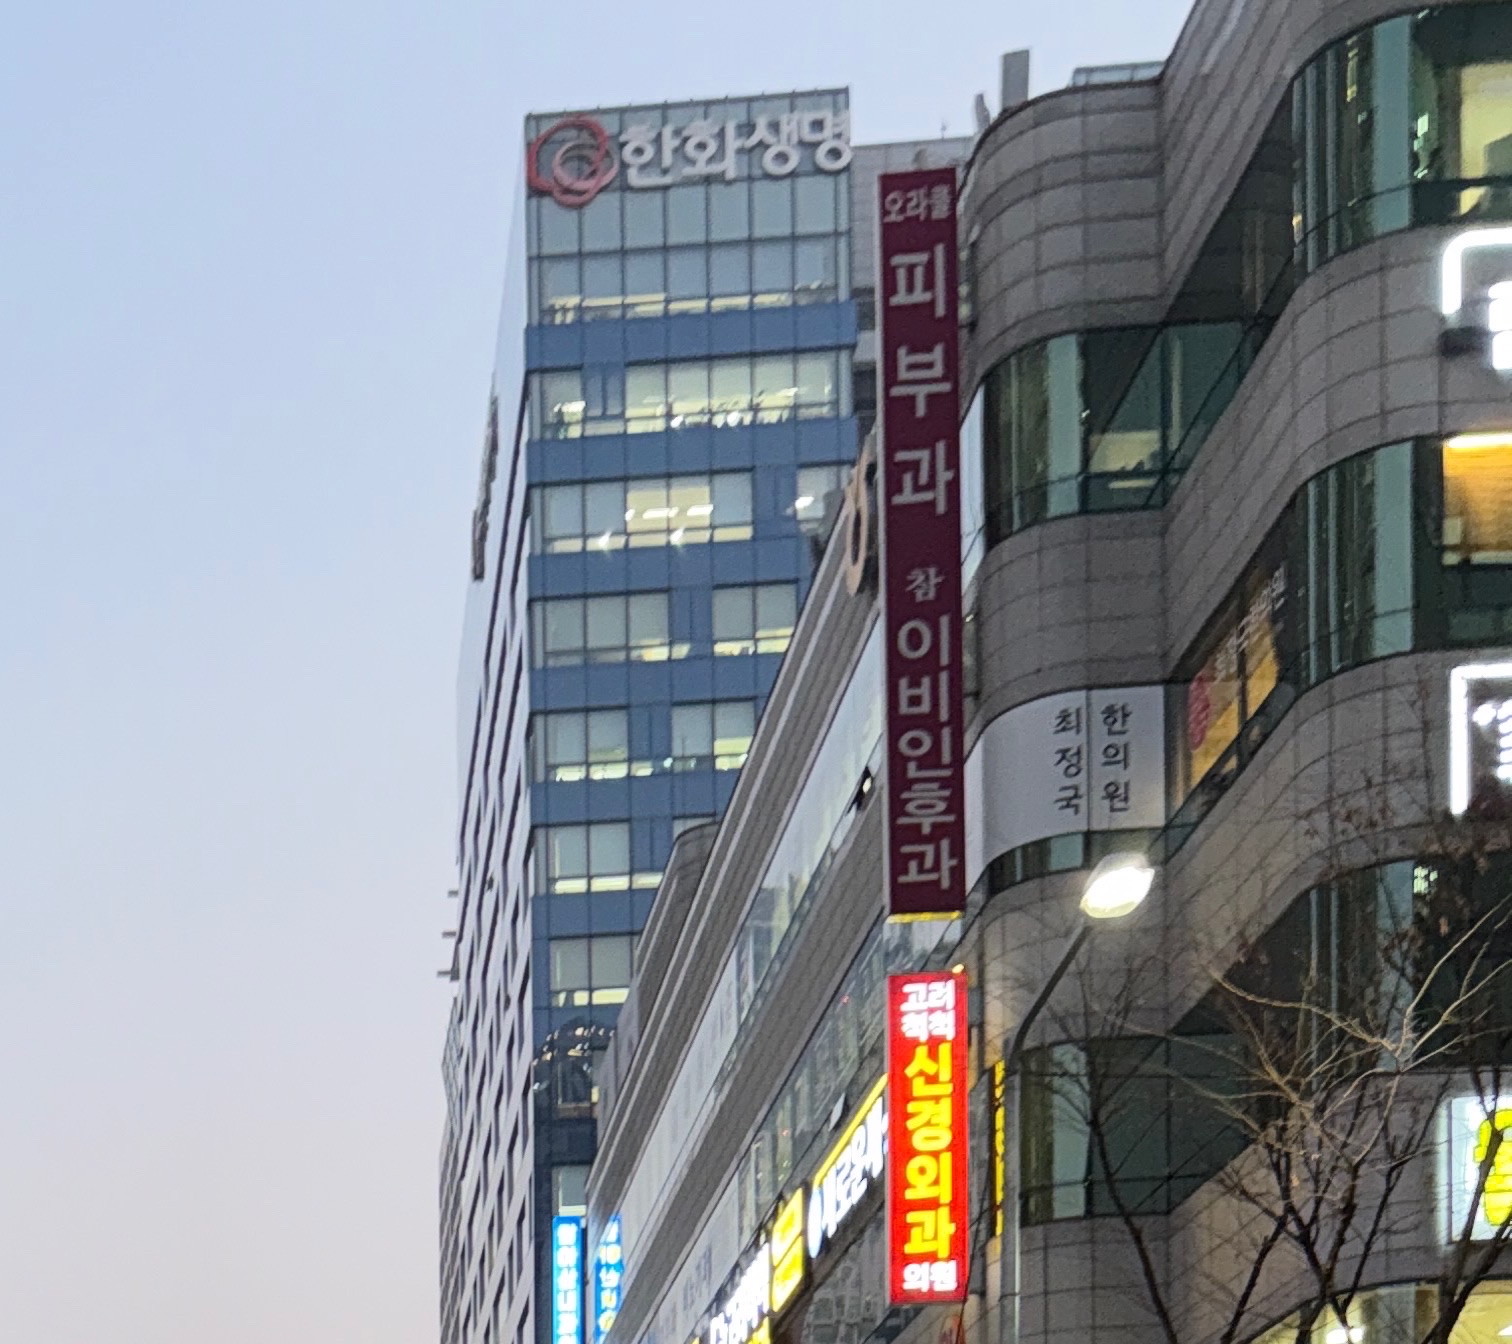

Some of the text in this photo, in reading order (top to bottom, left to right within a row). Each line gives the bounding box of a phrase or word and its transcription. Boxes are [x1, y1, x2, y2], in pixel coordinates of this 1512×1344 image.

[618, 105, 852, 189] 한화생명
[889, 242, 955, 516] 피부과
[896, 615, 958, 891] 이비인후과
[1100, 702, 1132, 814] 한의원
[900, 979, 956, 1012] 고려
[904, 1042, 956, 1258] 신경외과
[902, 1260, 957, 1292] 의원
